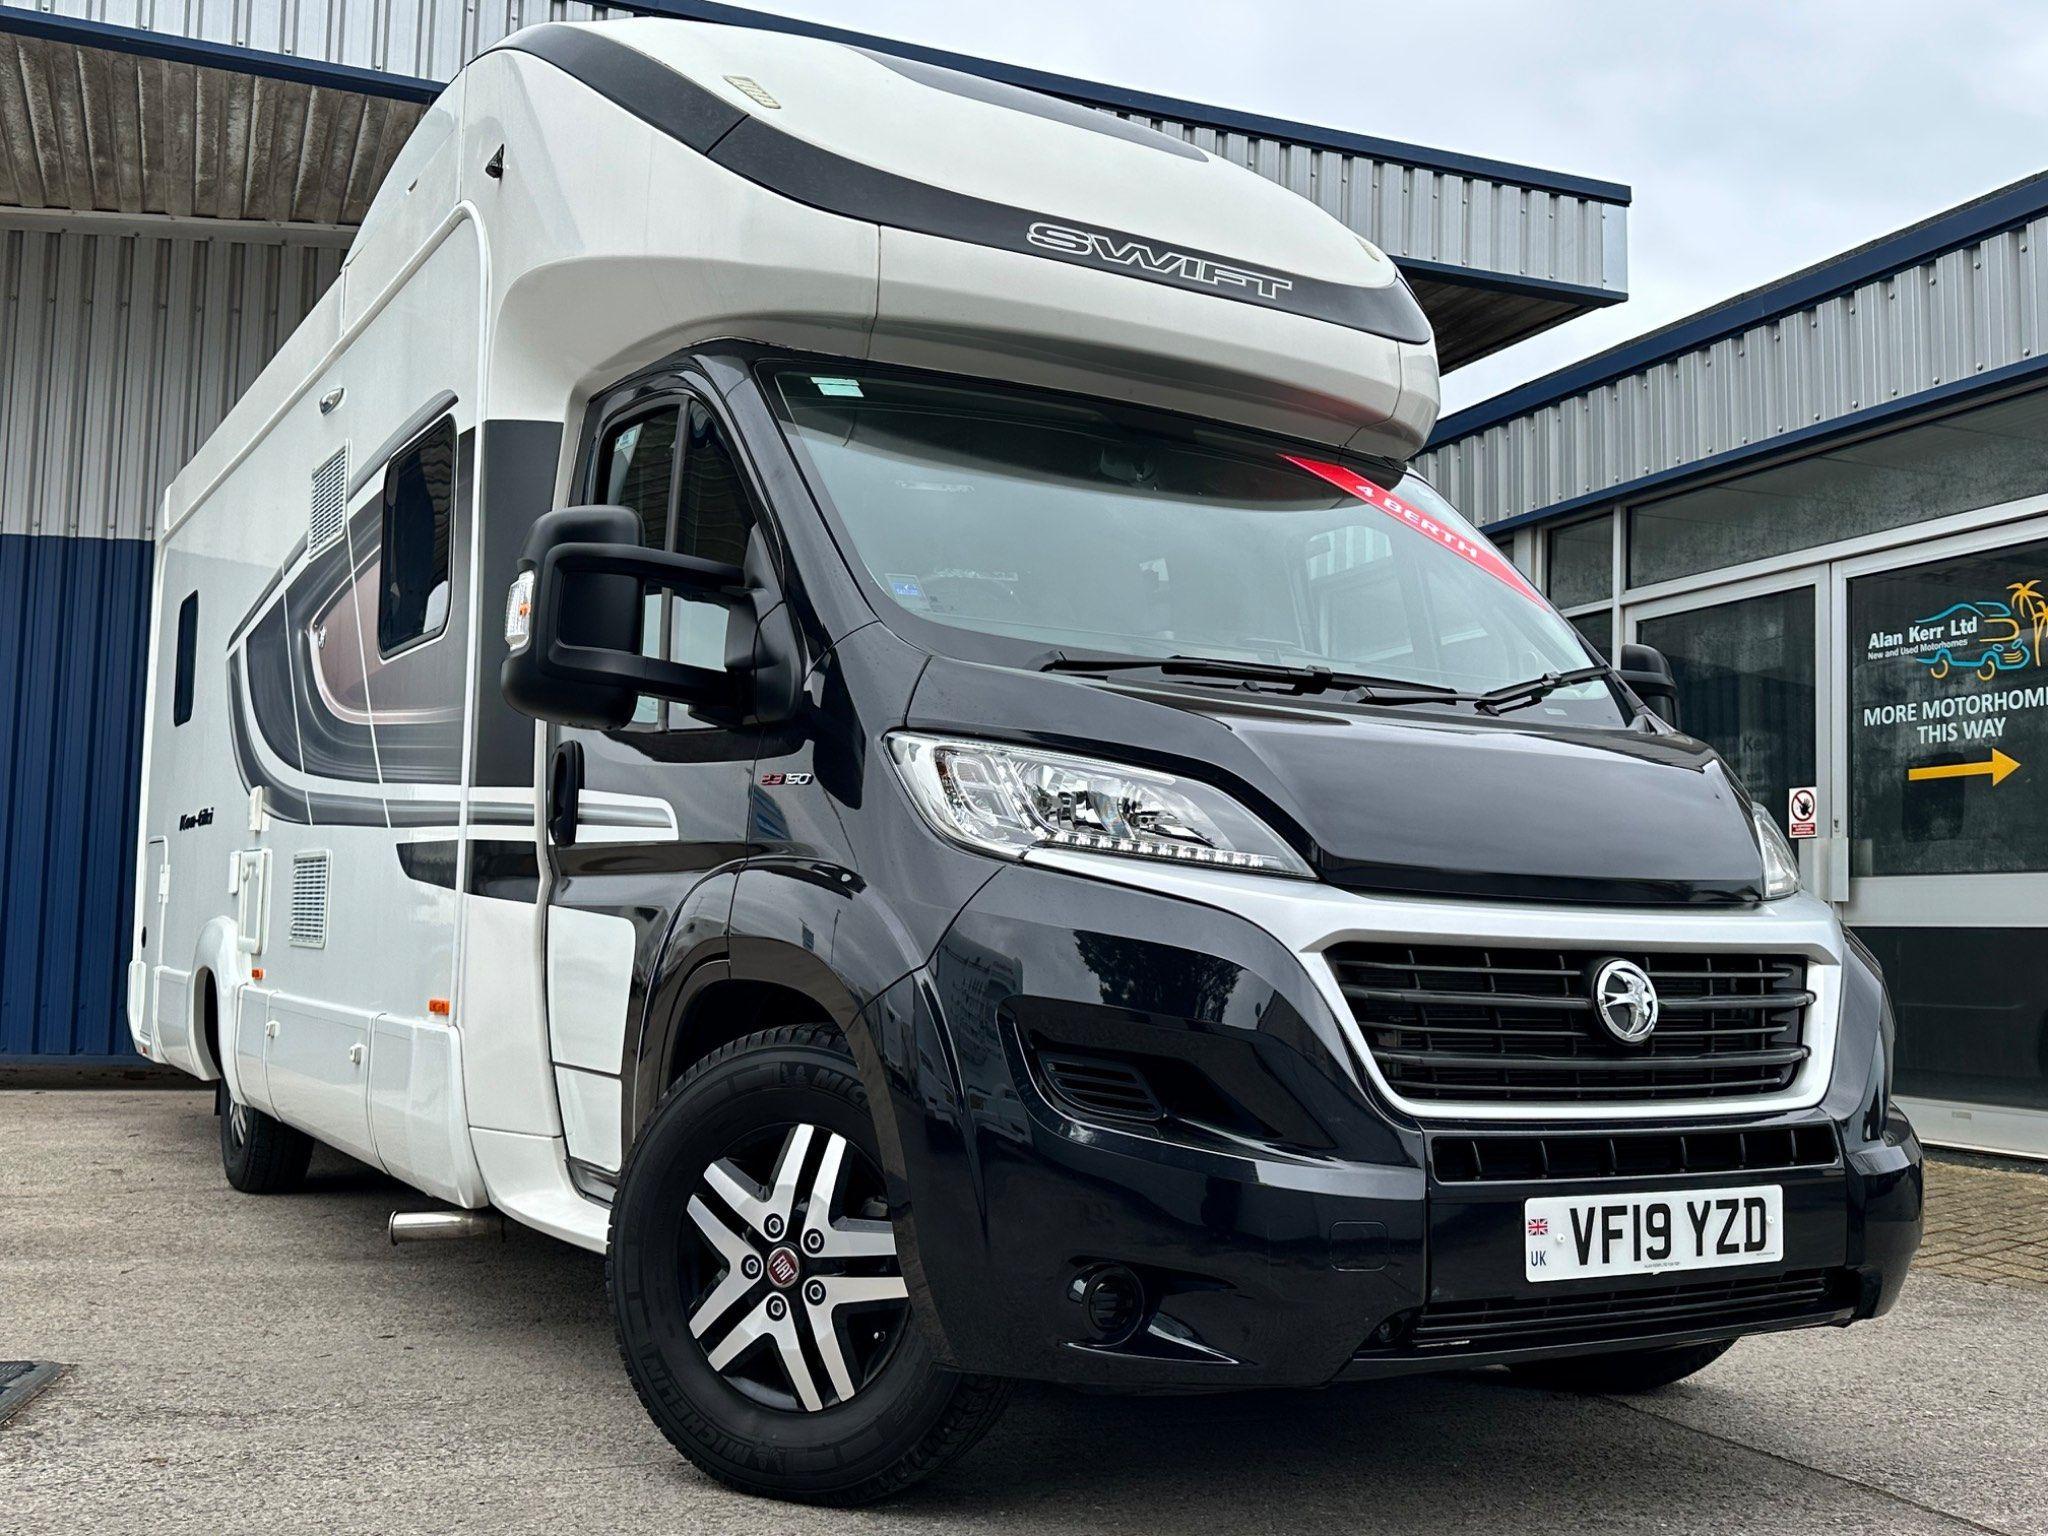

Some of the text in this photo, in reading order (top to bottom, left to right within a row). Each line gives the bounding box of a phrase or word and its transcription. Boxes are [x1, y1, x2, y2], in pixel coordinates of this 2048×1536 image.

[1026, 221, 1293, 300] SWIFT
[1355, 485, 1478, 559] 4 BERTH
[1867, 616, 1978, 650] Alan Kerr Ltd
[1867, 638, 1969, 661] New and Used Motorhomes
[1863, 686, 2048, 727] MORE MOTORHOM
[1917, 717, 2007, 745] THIS WAY
[1569, 1196, 1768, 1266] VF19 YZD
[772, 1254, 795, 1281] FIAT
[1530, 1250, 1547, 1268] UK
